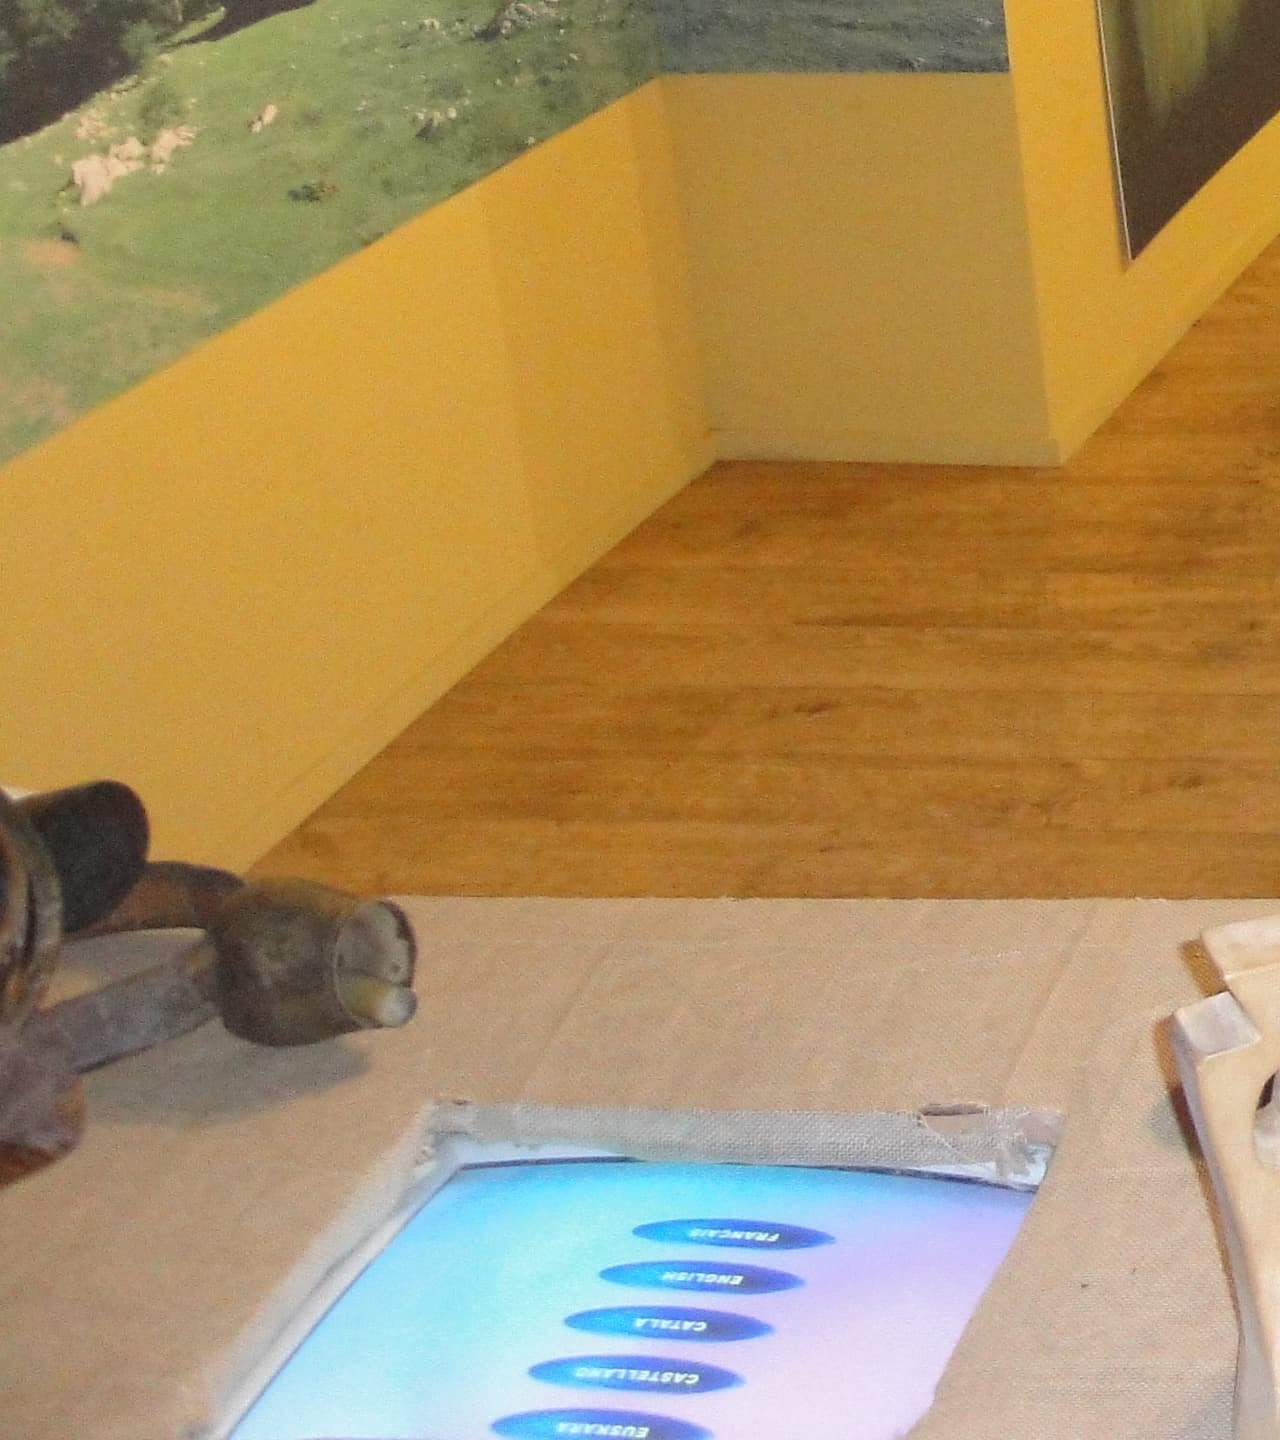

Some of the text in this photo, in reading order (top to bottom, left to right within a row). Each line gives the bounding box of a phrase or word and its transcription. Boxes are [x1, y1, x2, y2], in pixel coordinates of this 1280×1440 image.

[661, 1271, 745, 1286] ENGLISH
[575, 1366, 700, 1384] CASTELLANO
[556, 1421, 651, 1439] EUSKARA
